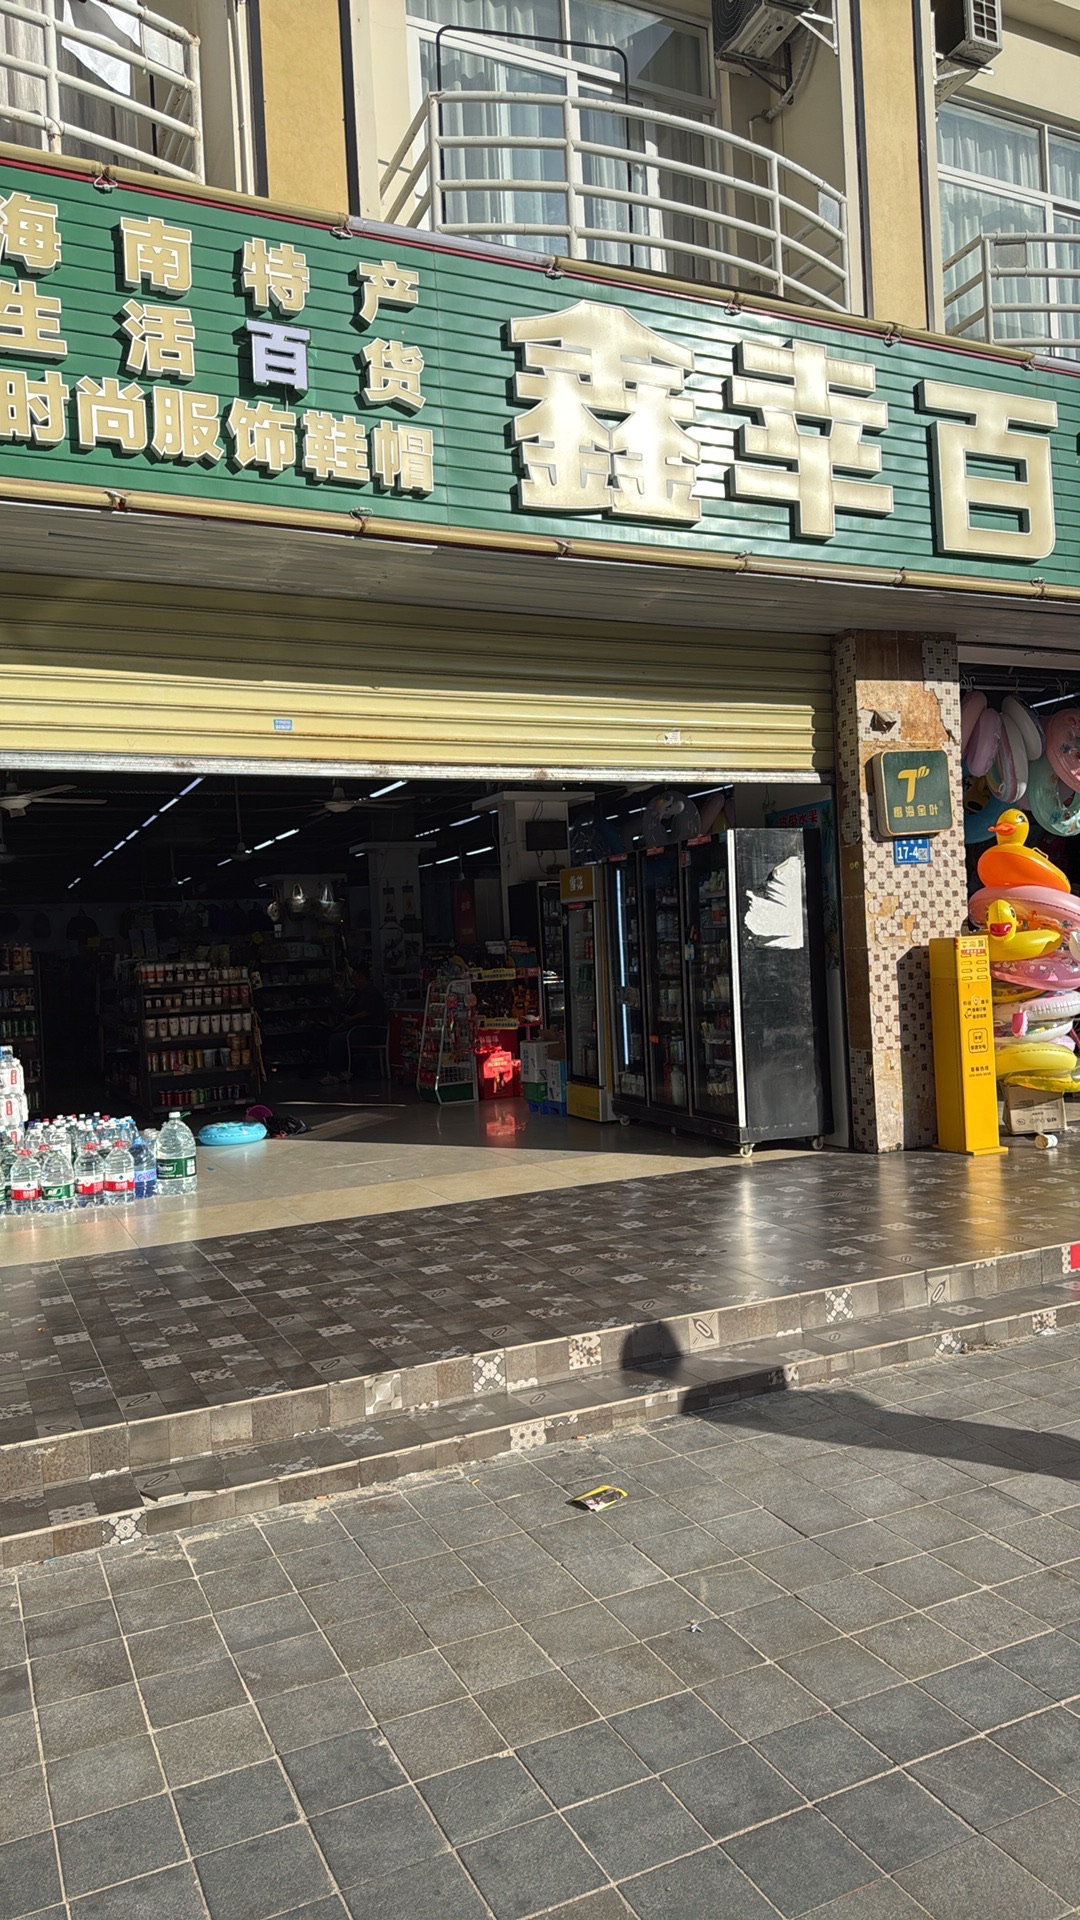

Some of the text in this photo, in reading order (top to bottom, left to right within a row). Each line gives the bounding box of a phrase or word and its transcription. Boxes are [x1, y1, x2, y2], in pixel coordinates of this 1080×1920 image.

[0, 191, 419, 324] 海南特产
[0, 280, 426, 412] 生活百货
[0, 369, 434, 496] 时尚服饰鞋帽
